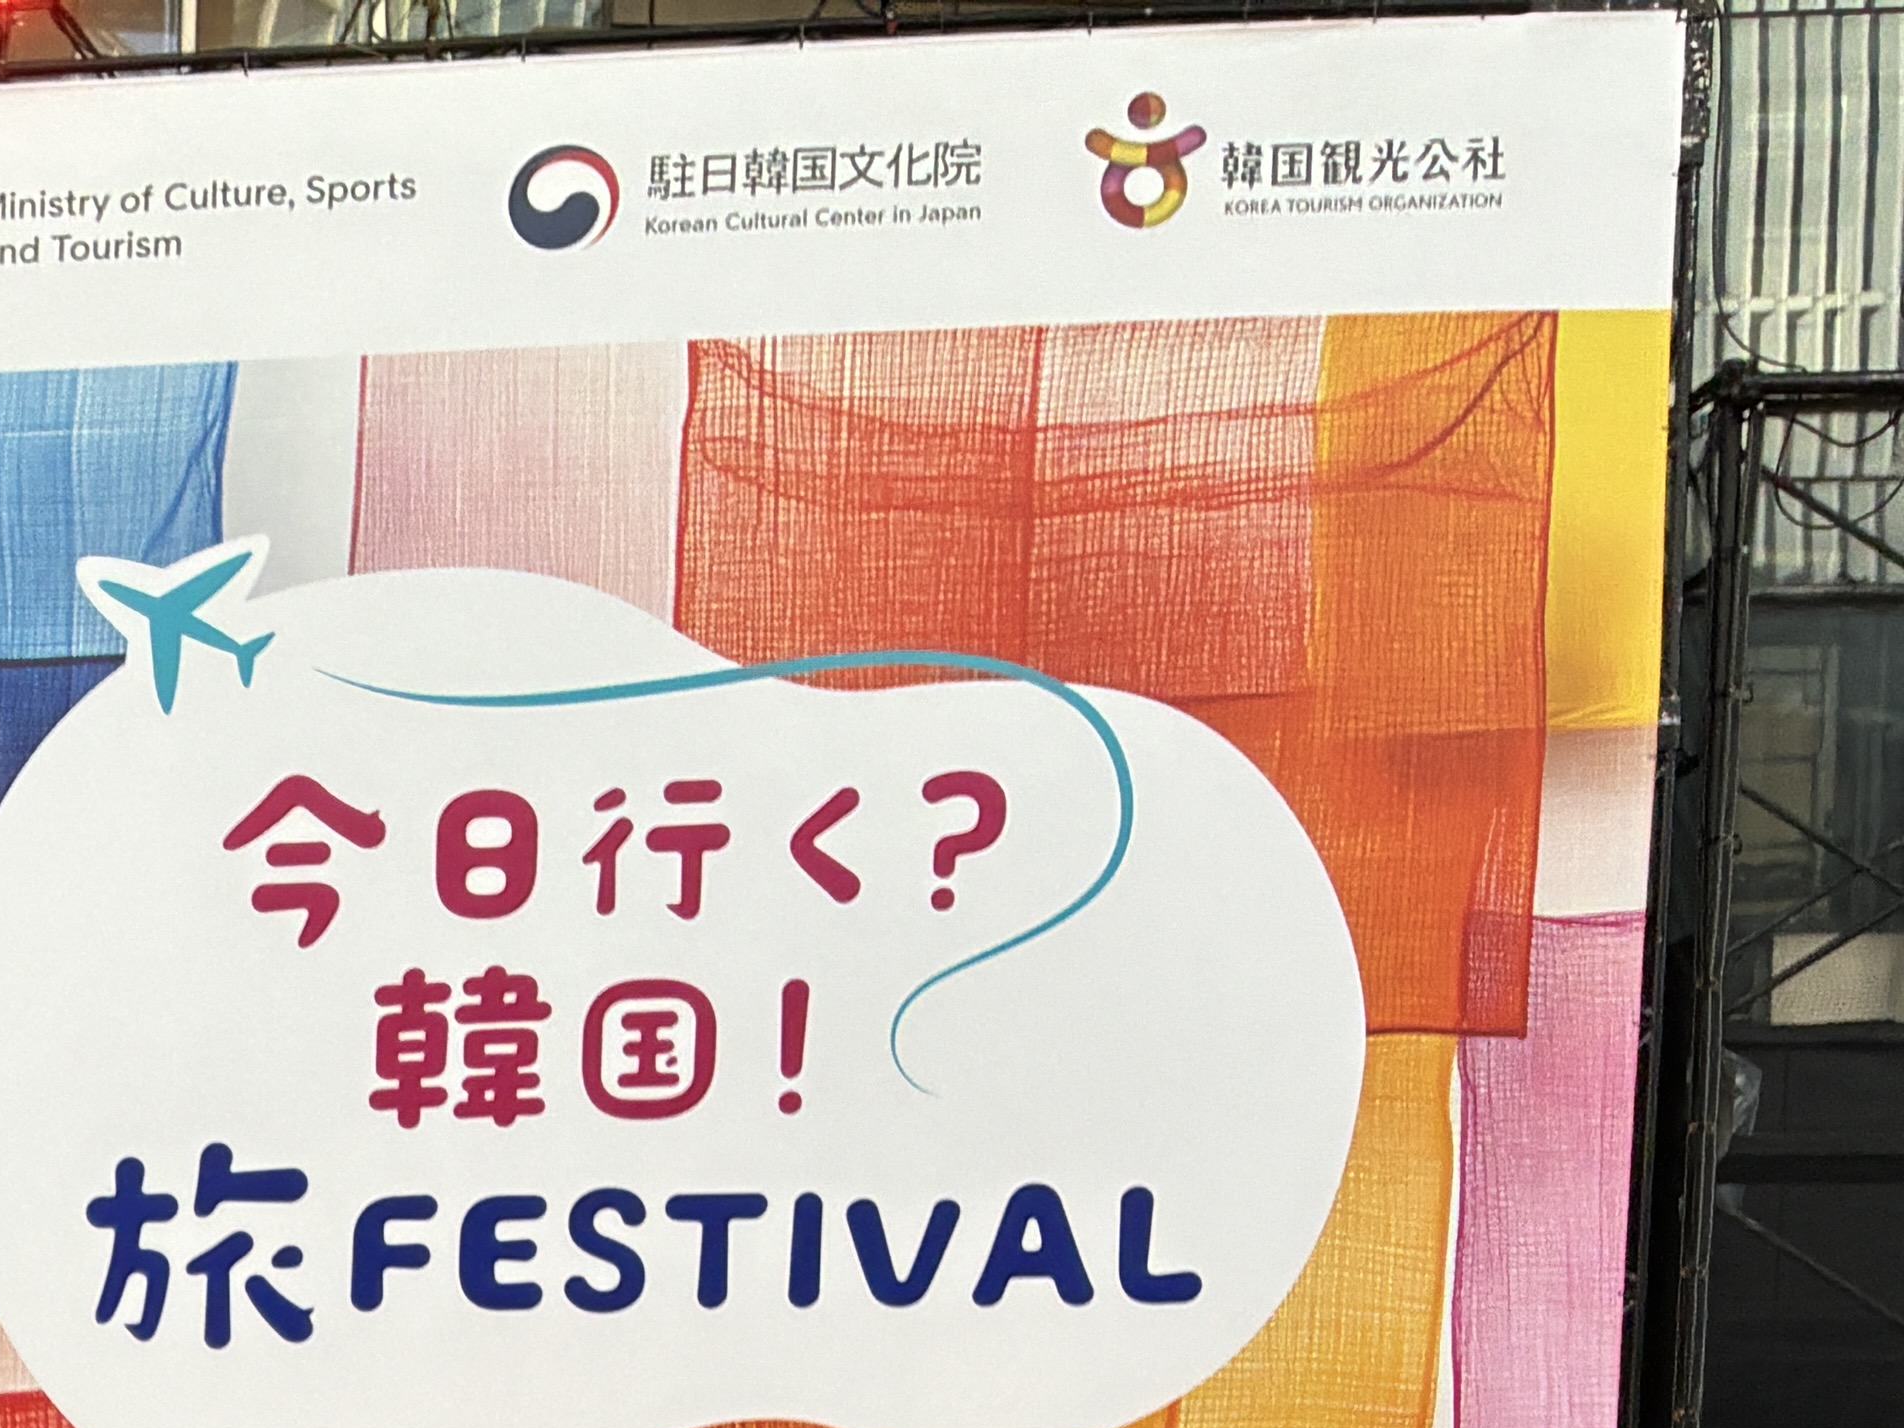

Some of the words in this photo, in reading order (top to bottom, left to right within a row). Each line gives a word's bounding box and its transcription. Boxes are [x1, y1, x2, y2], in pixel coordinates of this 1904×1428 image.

[646, 138, 983, 200] 駐日韓国文化院
[1219, 135, 1507, 191] 韓国観光公社
[119, 184, 154, 213] of
[164, 178, 296, 212] Culture,
[305, 172, 418, 212] Sports
[1223, 198, 1283, 216] KOREA
[1286, 196, 1364, 214] TOURISM
[1368, 192, 1503, 213] ORGANIZATION
[644, 213, 718, 236] Korean
[724, 208, 809, 233] Cultural
[815, 207, 884, 228] Center
[891, 204, 911, 224] in
[917, 203, 982, 227] Japan
[51, 231, 183, 262] Tourism
[222, 772, 1009, 948] 今日行く？
[368, 965, 812, 1128] 韓国！
